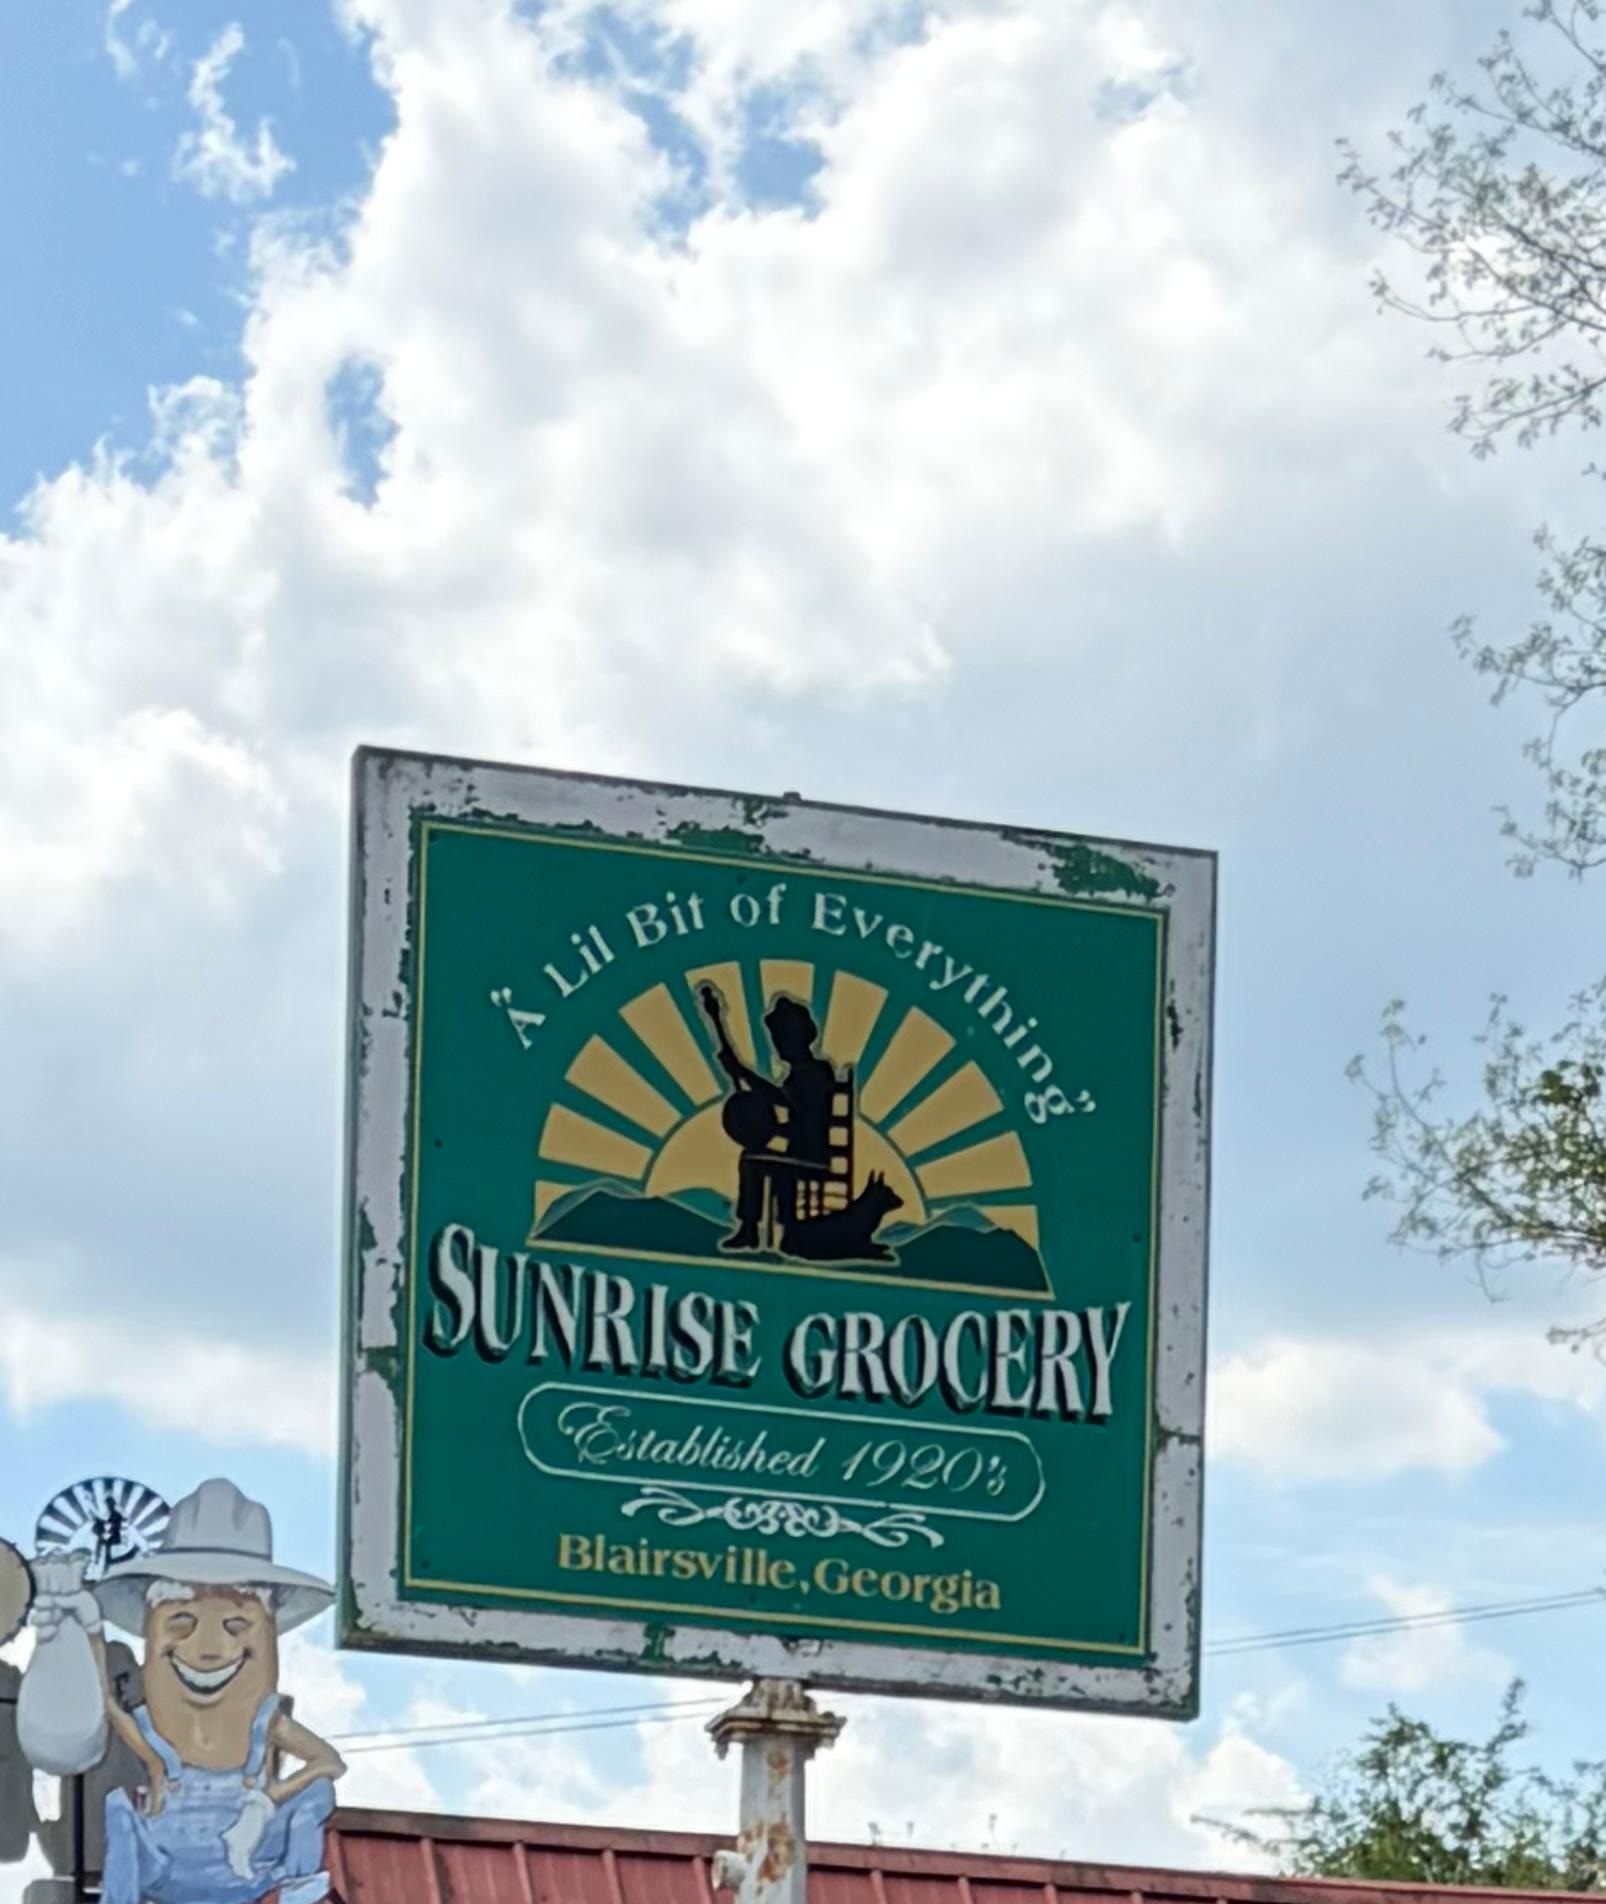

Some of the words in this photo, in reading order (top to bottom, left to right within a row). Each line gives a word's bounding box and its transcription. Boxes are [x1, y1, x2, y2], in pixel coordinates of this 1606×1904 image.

[543, 924, 616, 998] Lil
[625, 890, 705, 948] Bit
[730, 883, 788, 928] of
[425, 1223, 762, 1384] SUNRISE
[788, 1301, 1132, 1420] GROCERY
[556, 1401, 818, 1480] Established
[841, 1439, 1007, 1497] 1920's
